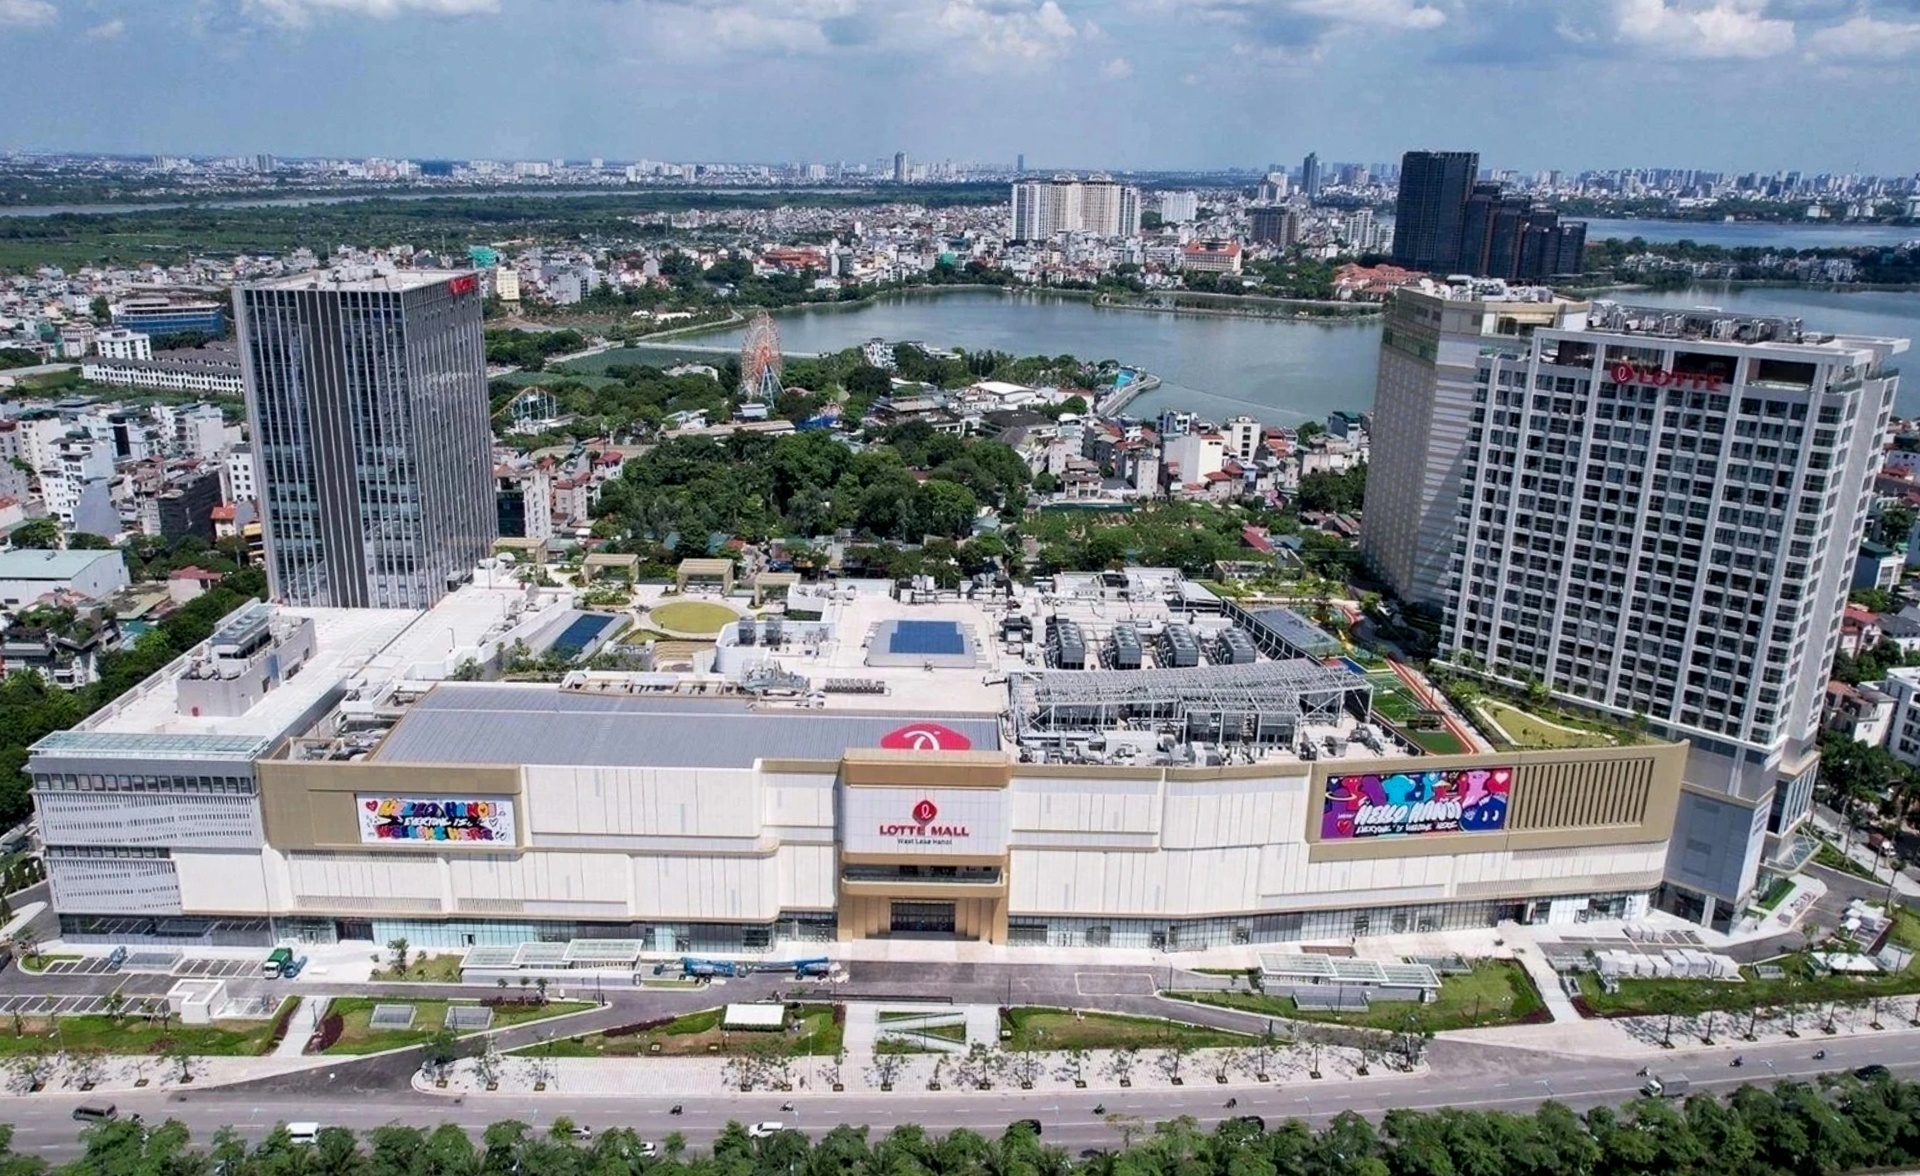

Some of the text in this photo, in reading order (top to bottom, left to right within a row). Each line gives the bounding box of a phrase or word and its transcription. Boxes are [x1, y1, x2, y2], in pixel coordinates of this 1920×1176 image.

[1638, 370, 1725, 391] LOTTE
[378, 799, 497, 817] HELLO HANOI
[1354, 800, 1462, 825] HELLO HANOI
[375, 825, 446, 841] WELCOME
[880, 825, 969, 837] LOTTE MALL
